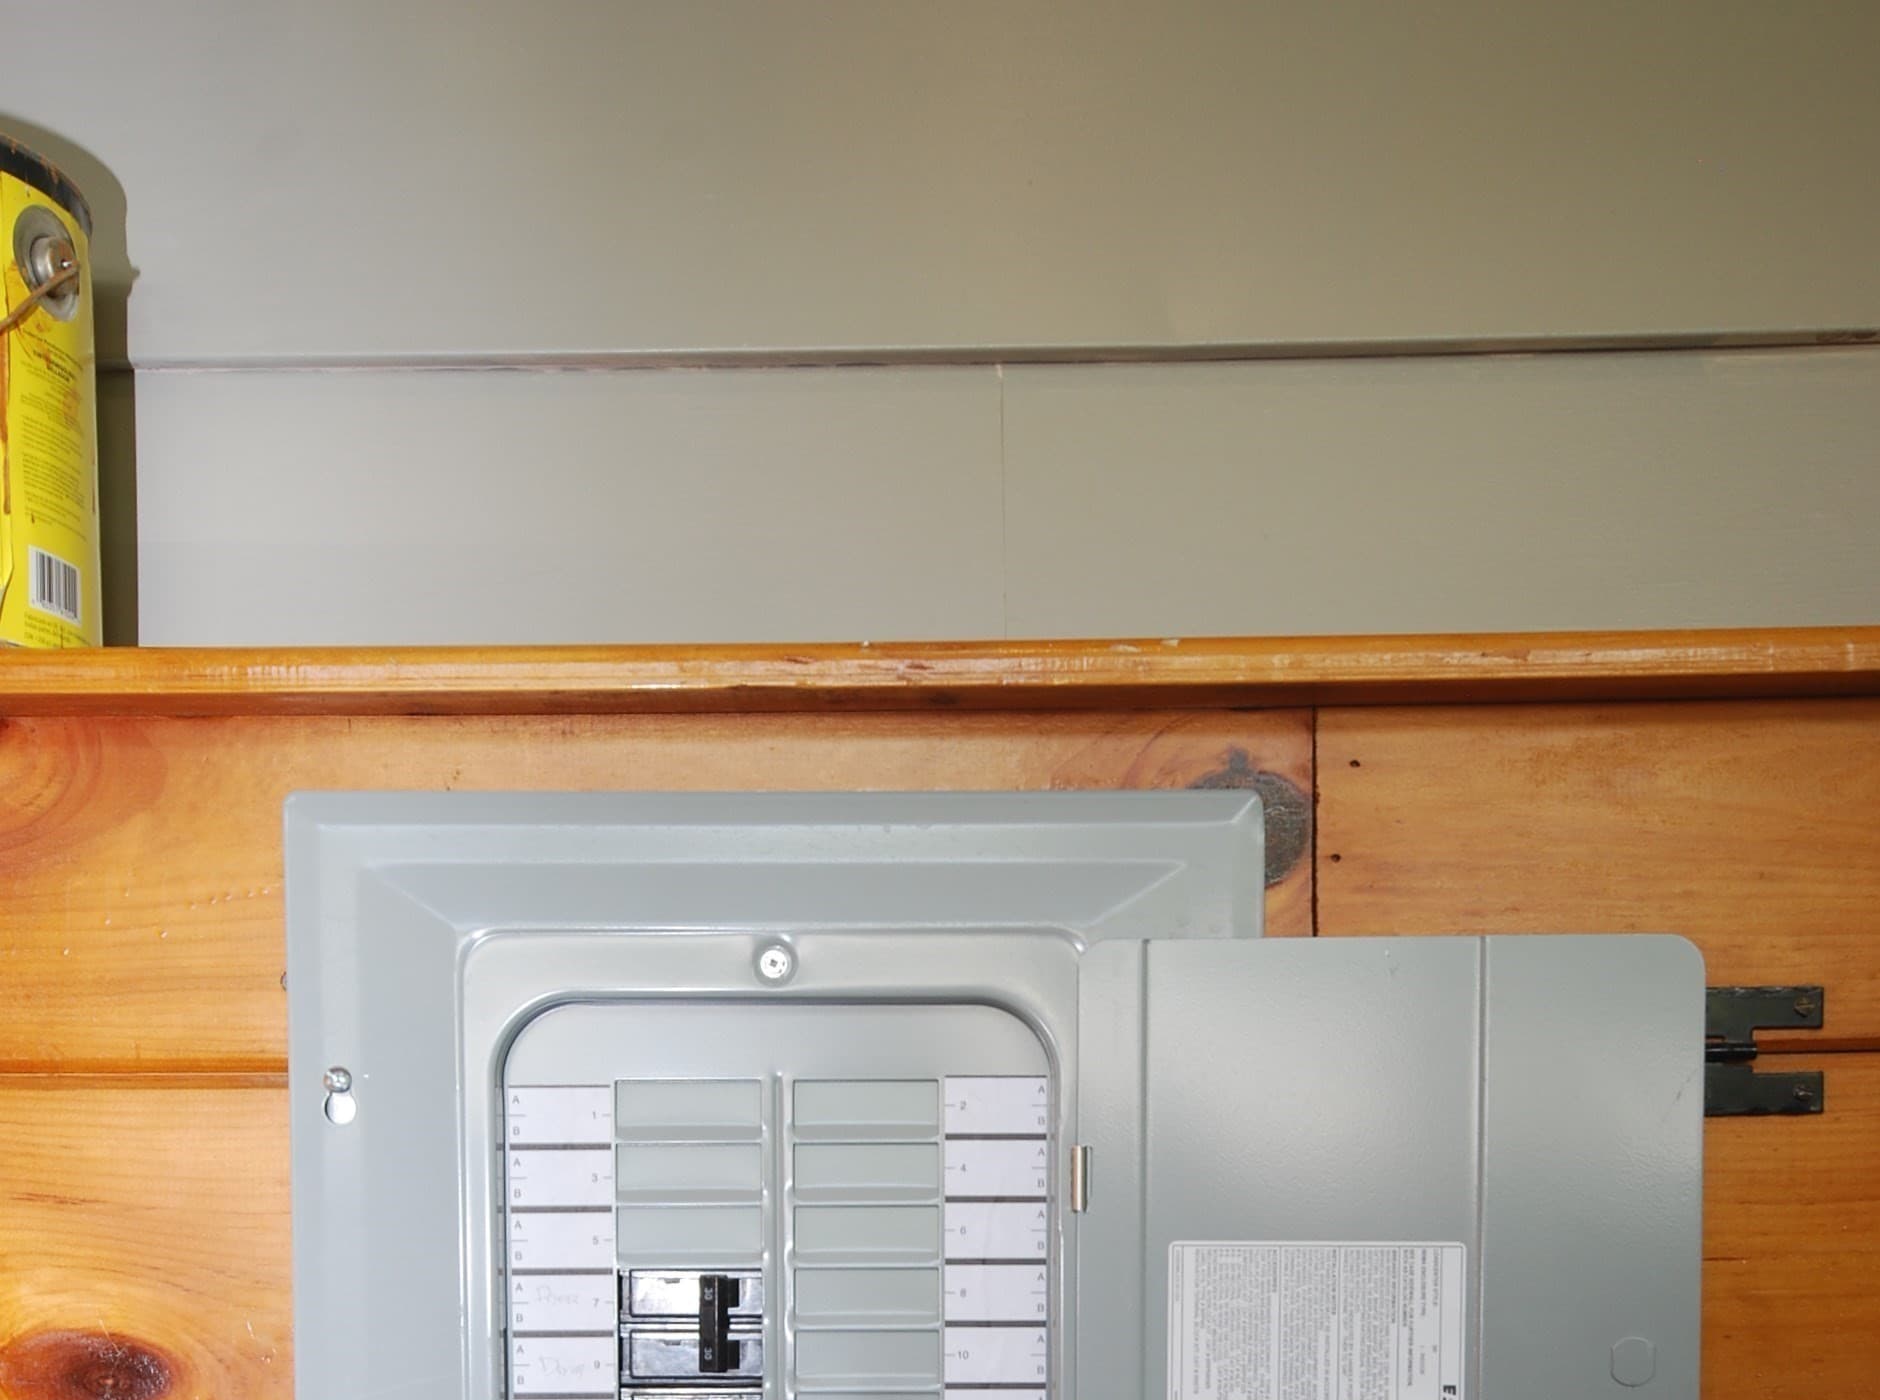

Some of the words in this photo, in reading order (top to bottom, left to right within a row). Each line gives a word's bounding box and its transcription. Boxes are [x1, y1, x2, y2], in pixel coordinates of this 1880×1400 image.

[1038, 1086, 1045, 1094] A
[512, 1096, 520, 1104] A
[960, 1101, 967, 1110] 2
[592, 1111, 597, 1119] 1
[1038, 1148, 1044, 1156] A
[513, 1158, 520, 1167] A
[960, 1164, 967, 1172] 4
[592, 1174, 598, 1182] 3
[1038, 1210, 1044, 1219] A
[514, 1220, 522, 1230] A
[592, 1236, 598, 1244] 5
[1037, 1272, 1044, 1281] A
[515, 1282, 523, 1291] A
[703, 1287, 713, 1301] 30
[592, 1298, 599, 1307] 7
[1036, 1334, 1044, 1343] A
[516, 1344, 524, 1354] A
[703, 1346, 713, 1360] 30
[958, 1350, 969, 1360] 10
